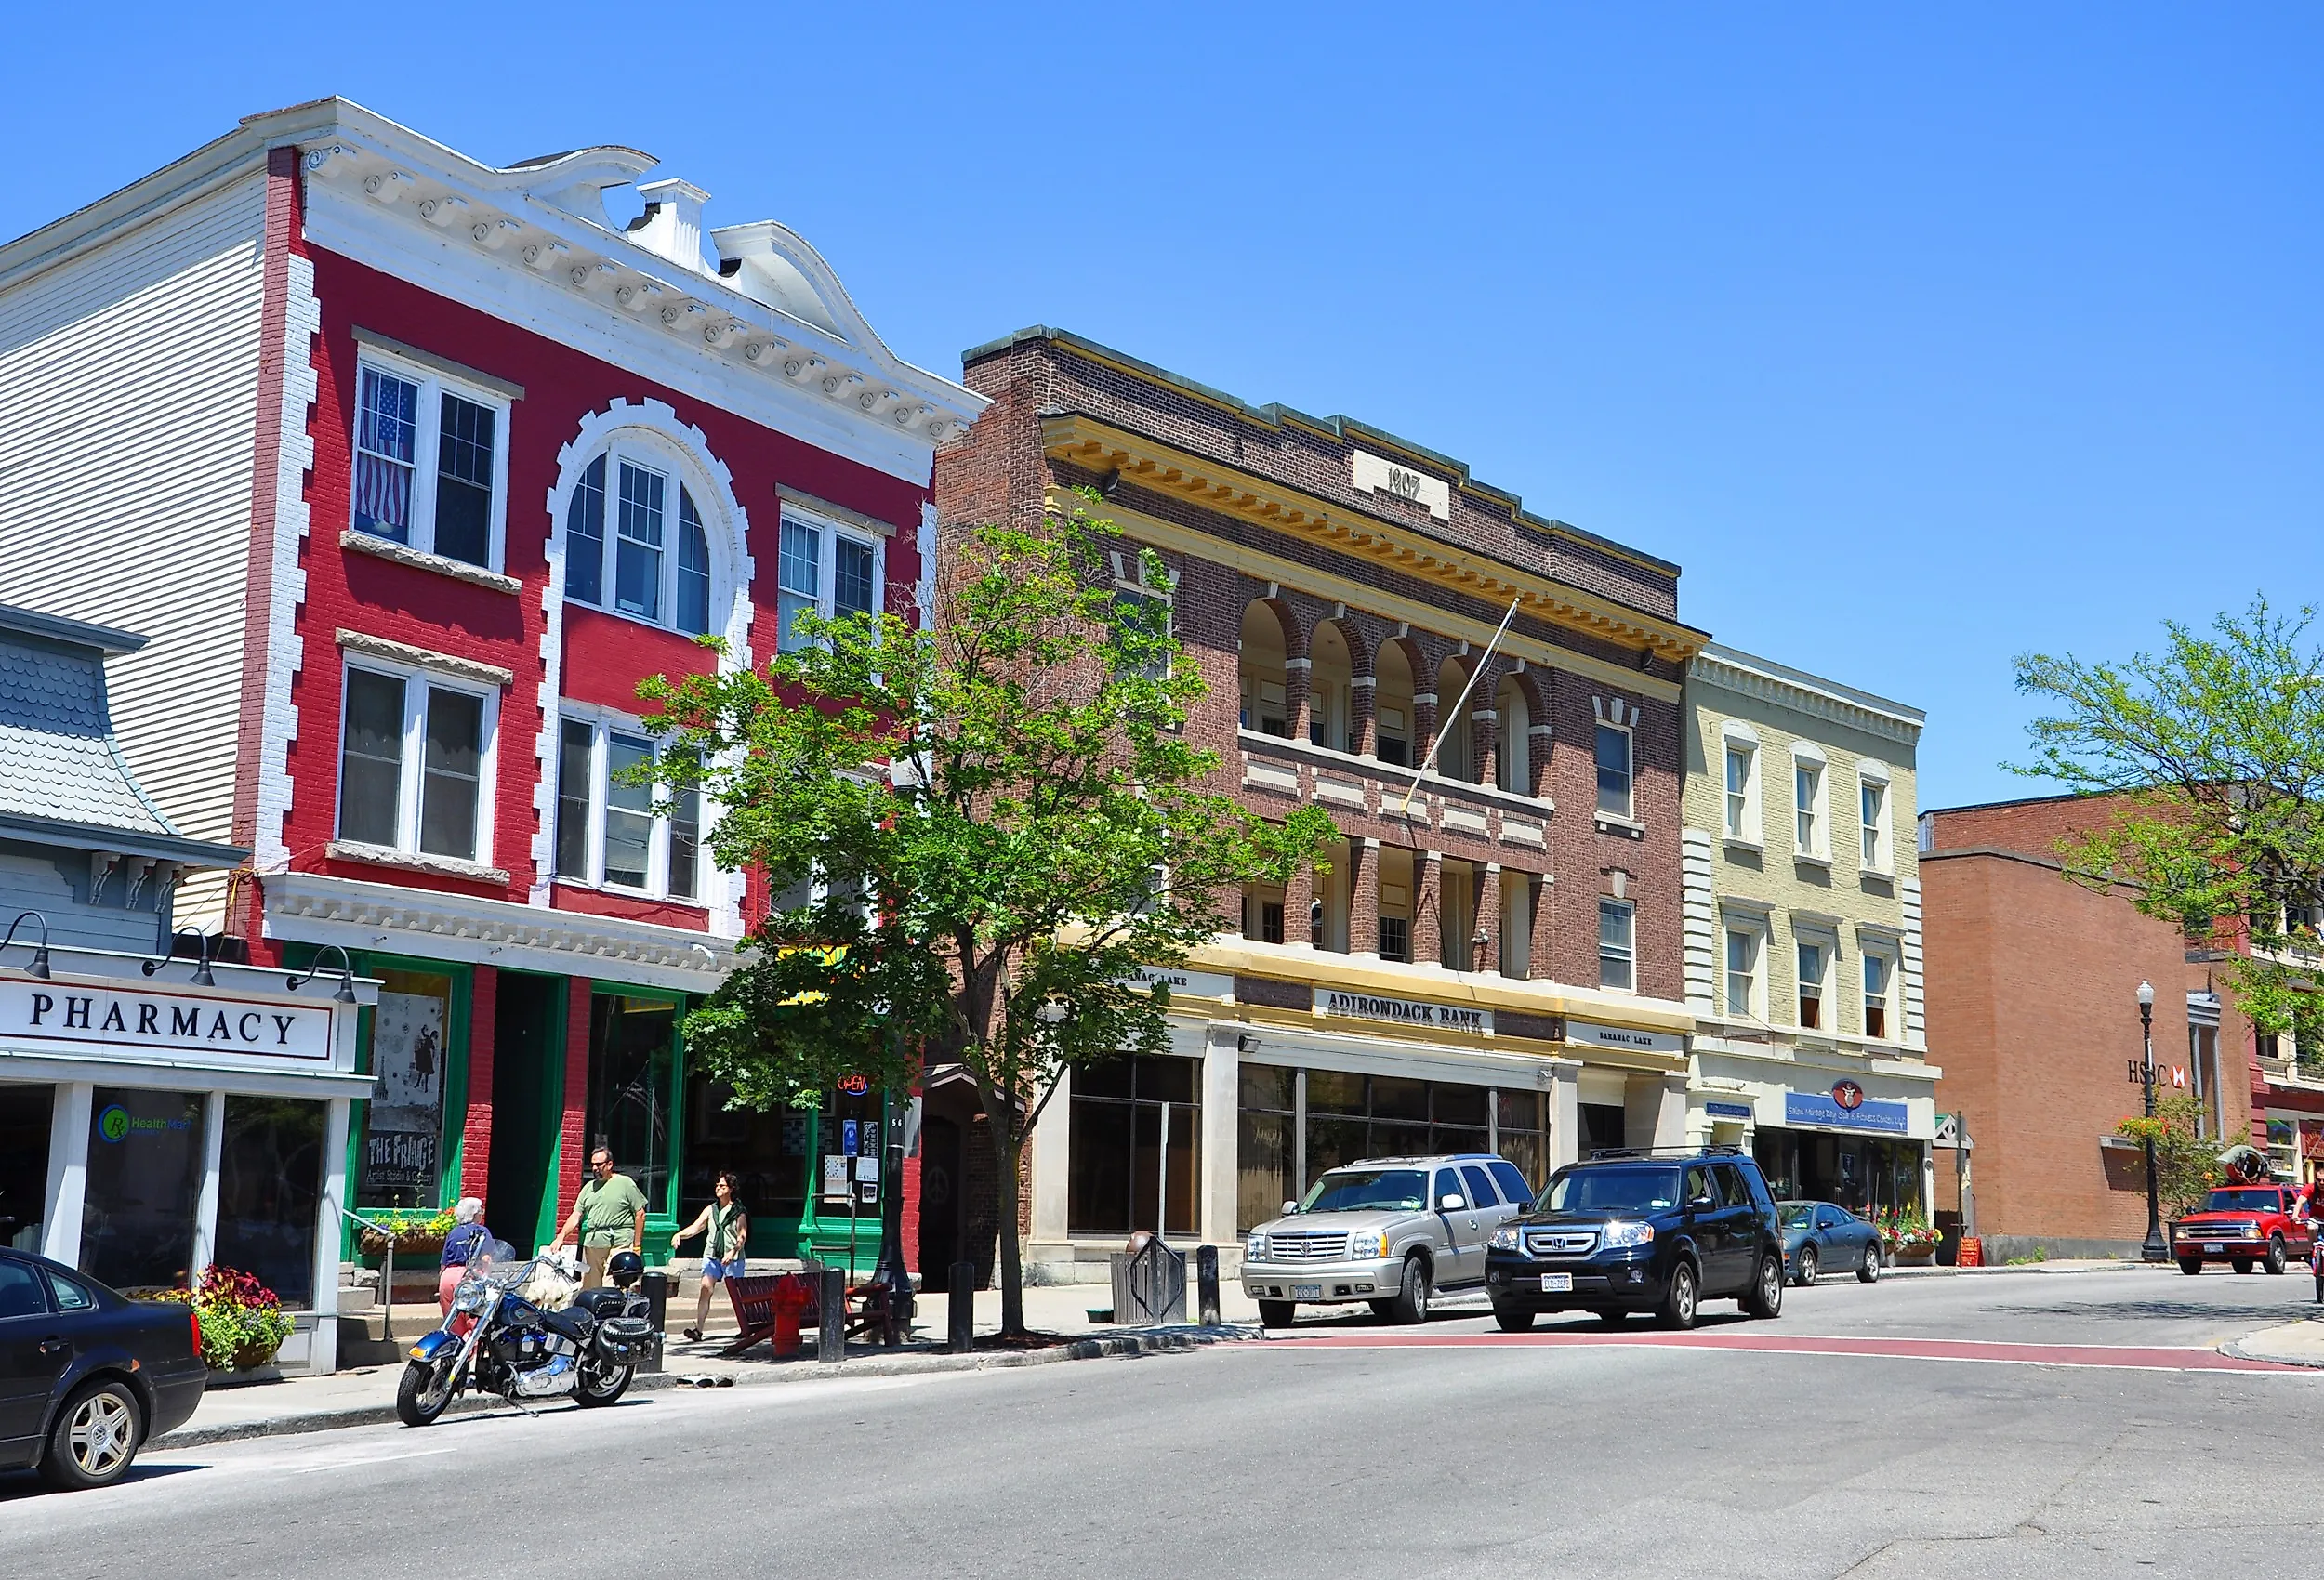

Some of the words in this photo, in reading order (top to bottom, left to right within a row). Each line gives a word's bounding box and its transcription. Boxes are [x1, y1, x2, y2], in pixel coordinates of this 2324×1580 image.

[1388, 466, 1421, 494] 1907
[1161, 975, 1187, 986] LAKE
[29, 994, 296, 1045] PHARMACY
[1328, 994, 1434, 1022] ADIRONDACK
[1440, 1008, 1482, 1028] BANK
[1599, 1032, 1631, 1043] SARANAC
[1634, 1036, 1653, 1046] LAKE
[838, 1075, 865, 1090] OPEN
[369, 1137, 390, 1165] THE
[393, 1134, 434, 1171] FRINGE
